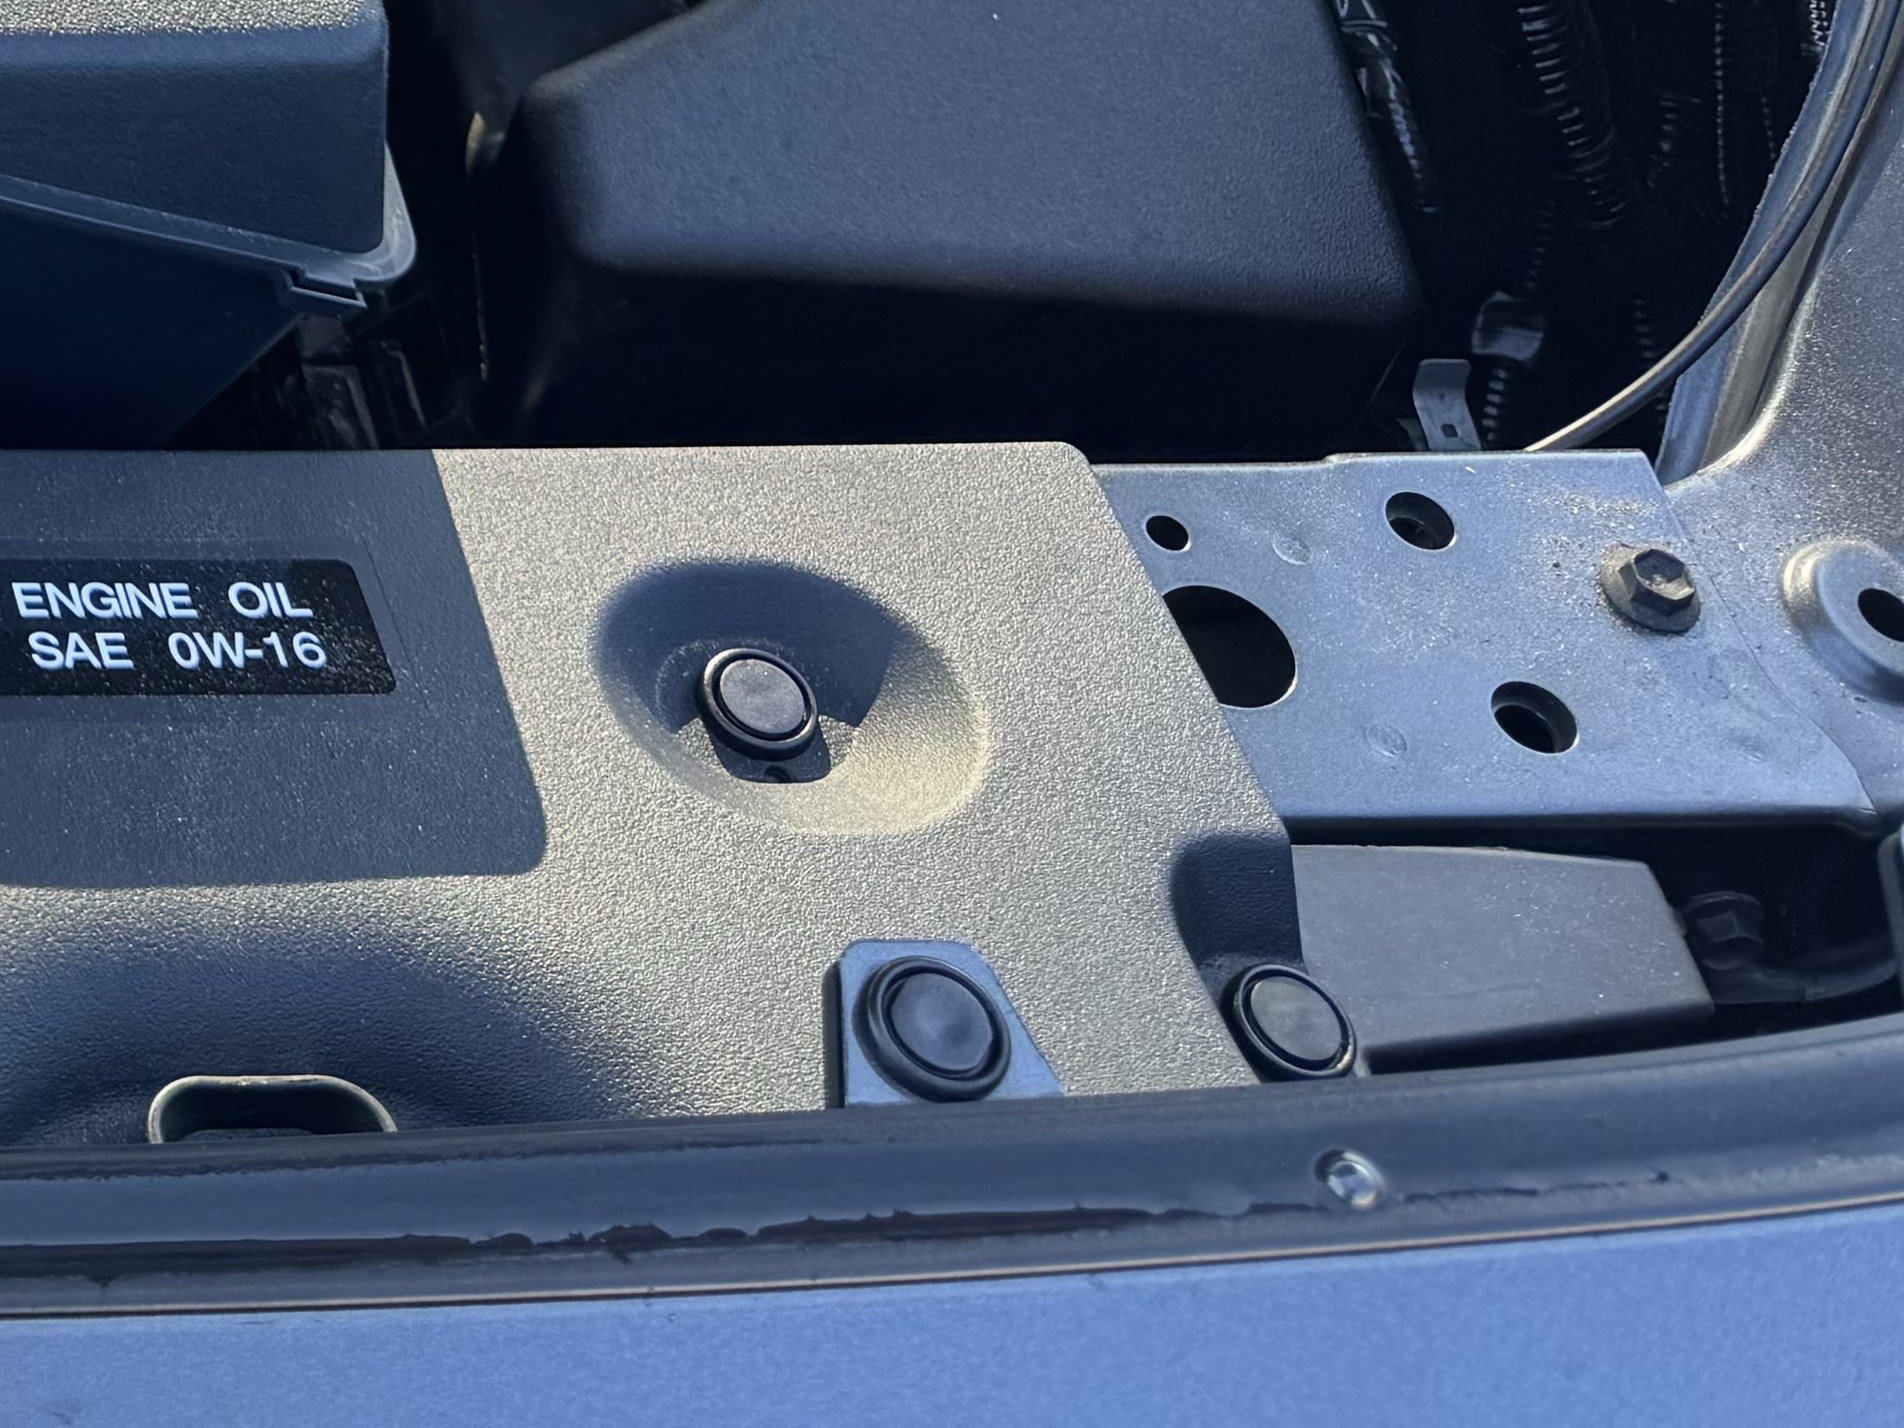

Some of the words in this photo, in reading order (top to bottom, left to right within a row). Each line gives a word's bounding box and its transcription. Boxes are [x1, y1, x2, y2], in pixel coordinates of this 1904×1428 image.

[11, 581, 199, 621] ENGINE
[227, 579, 314, 621] OIL
[30, 631, 135, 671] SAE
[168, 631, 328, 671] 0W-16
